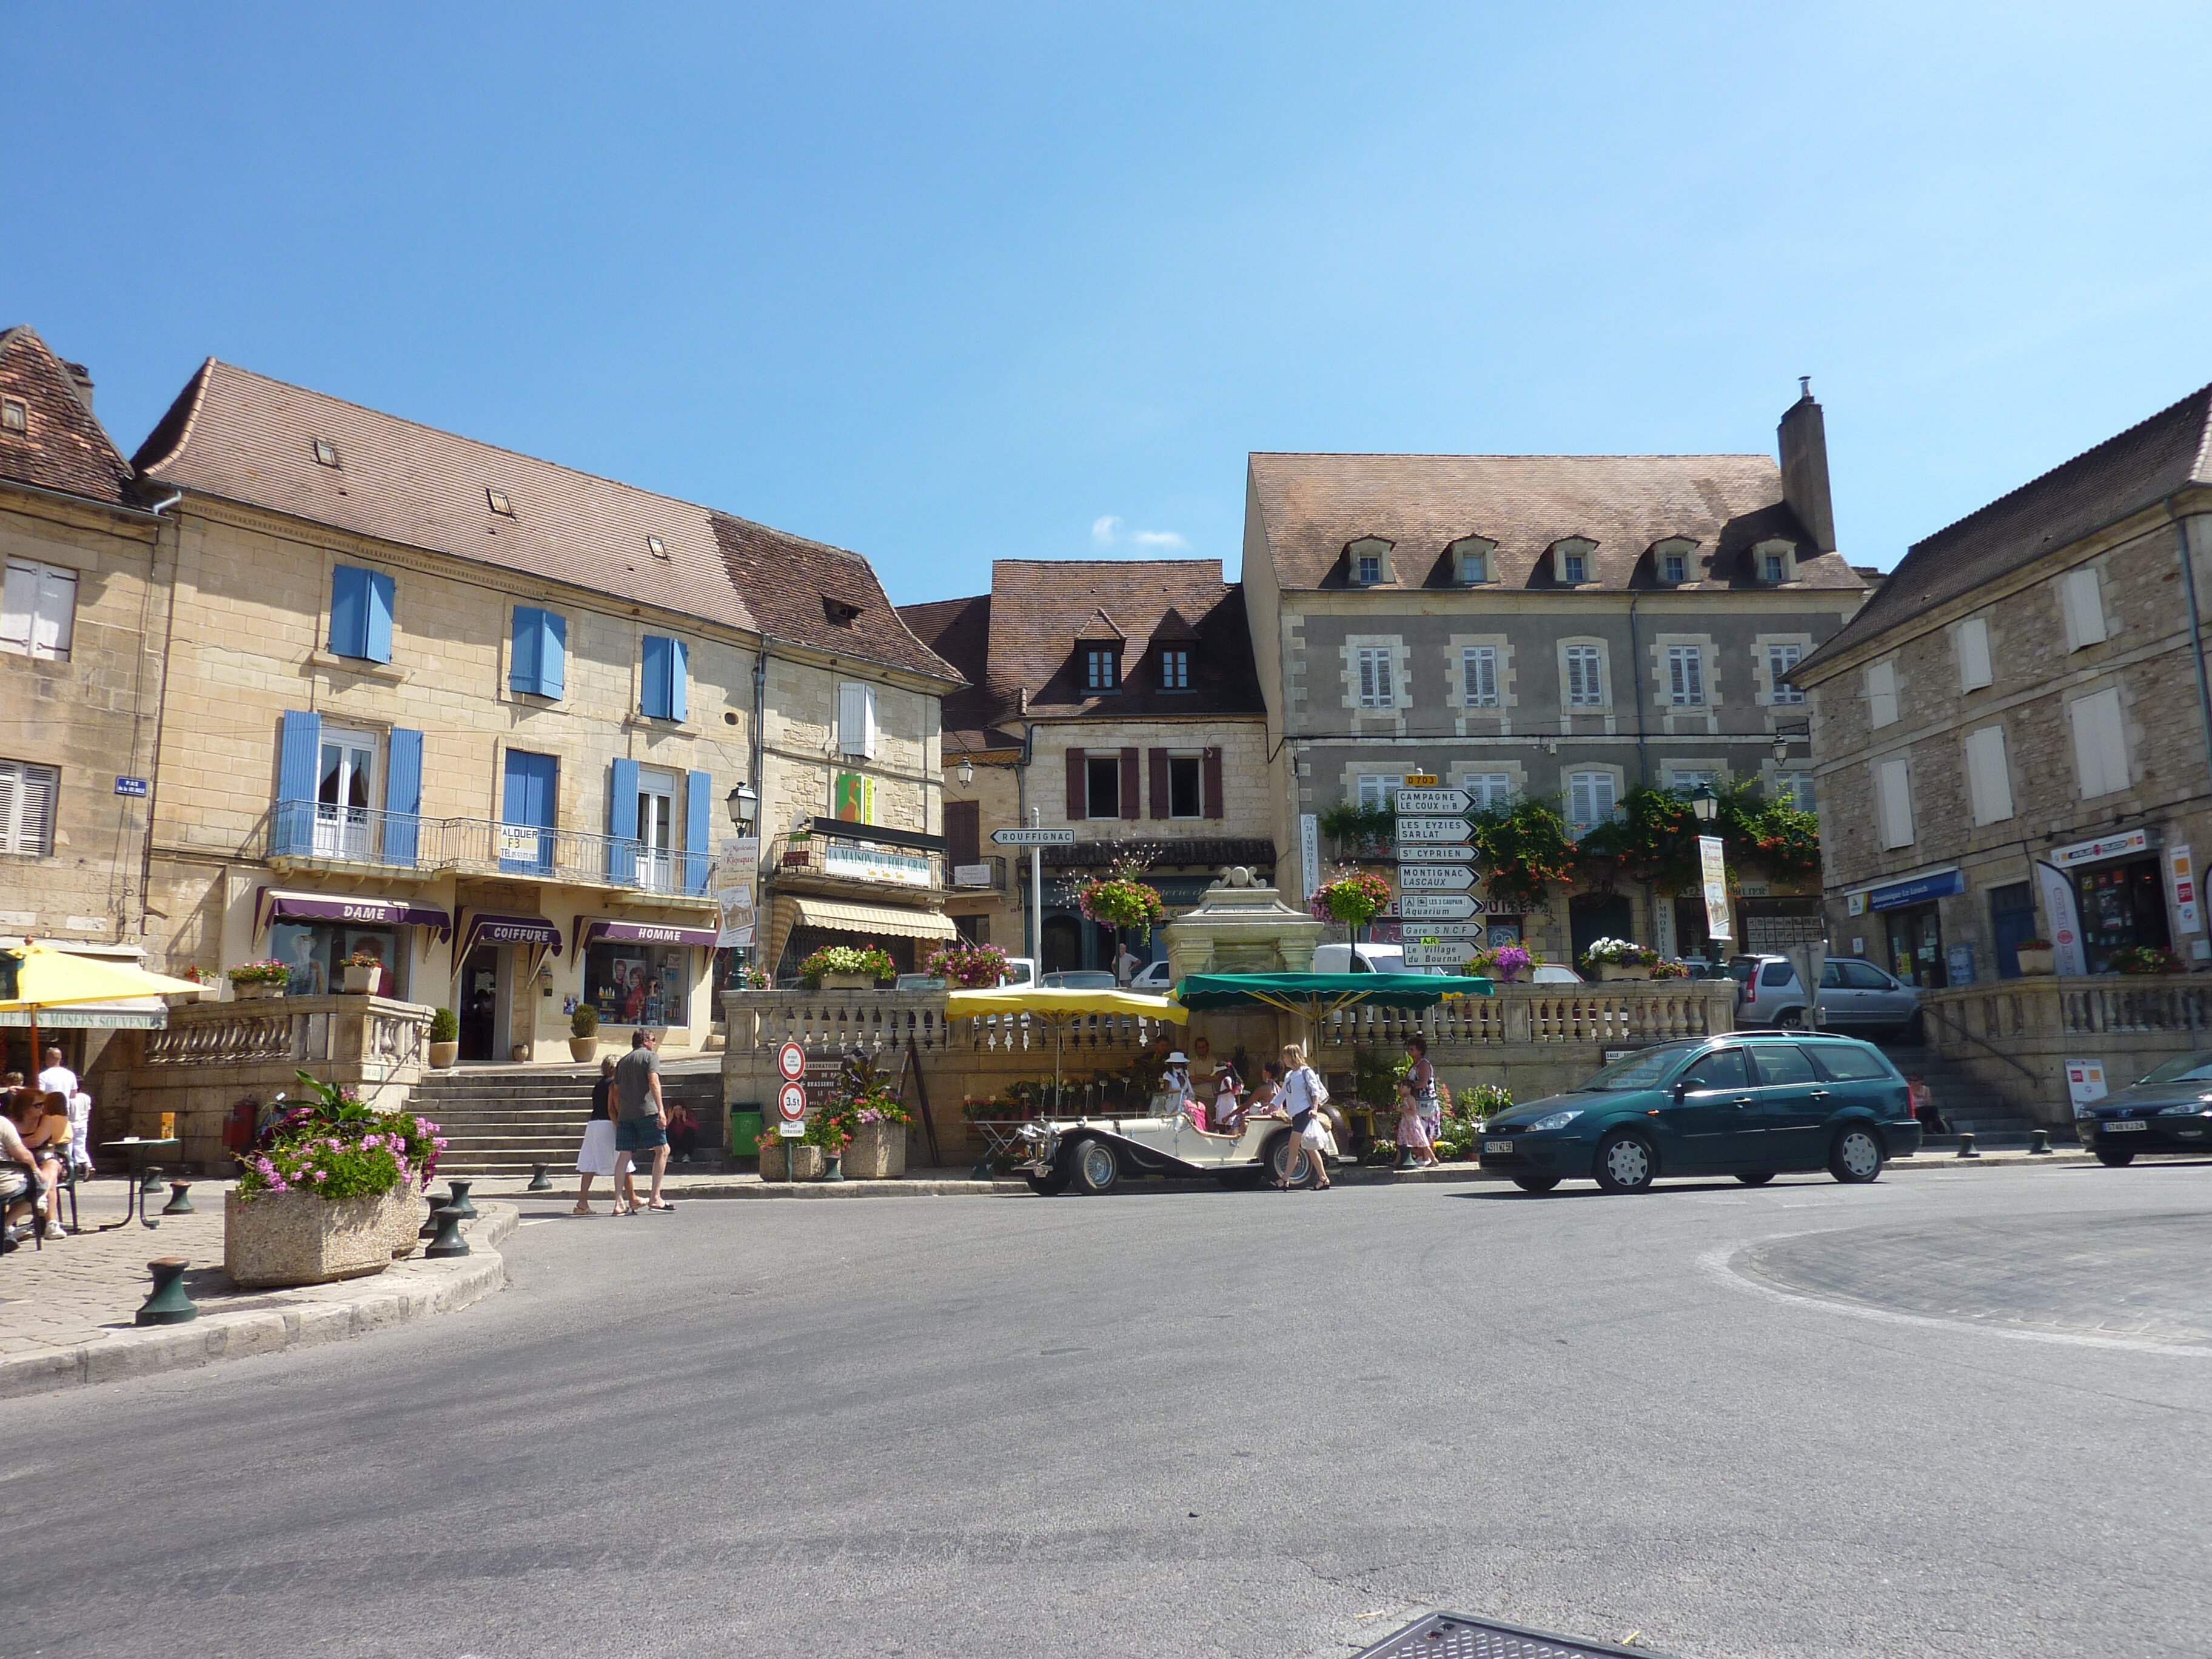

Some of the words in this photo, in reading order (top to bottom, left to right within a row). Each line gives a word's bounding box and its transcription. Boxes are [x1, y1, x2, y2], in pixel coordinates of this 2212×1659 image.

[508, 838, 520, 848] F3
[828, 849, 837, 862] LA
[841, 849, 873, 866] MAISON
[875, 856, 885, 868] DU
[888, 856, 905, 871] FOIE
[908, 859, 928, 873] GRAS
[344, 905, 386, 919] DAME
[1405, 908, 1449, 916] Aquarium
[494, 927, 549, 940] COIFFURE
[638, 927, 682, 940] HOMME
[1424, 946, 1456, 955] Village
[23, 1013, 43, 1025] DS
